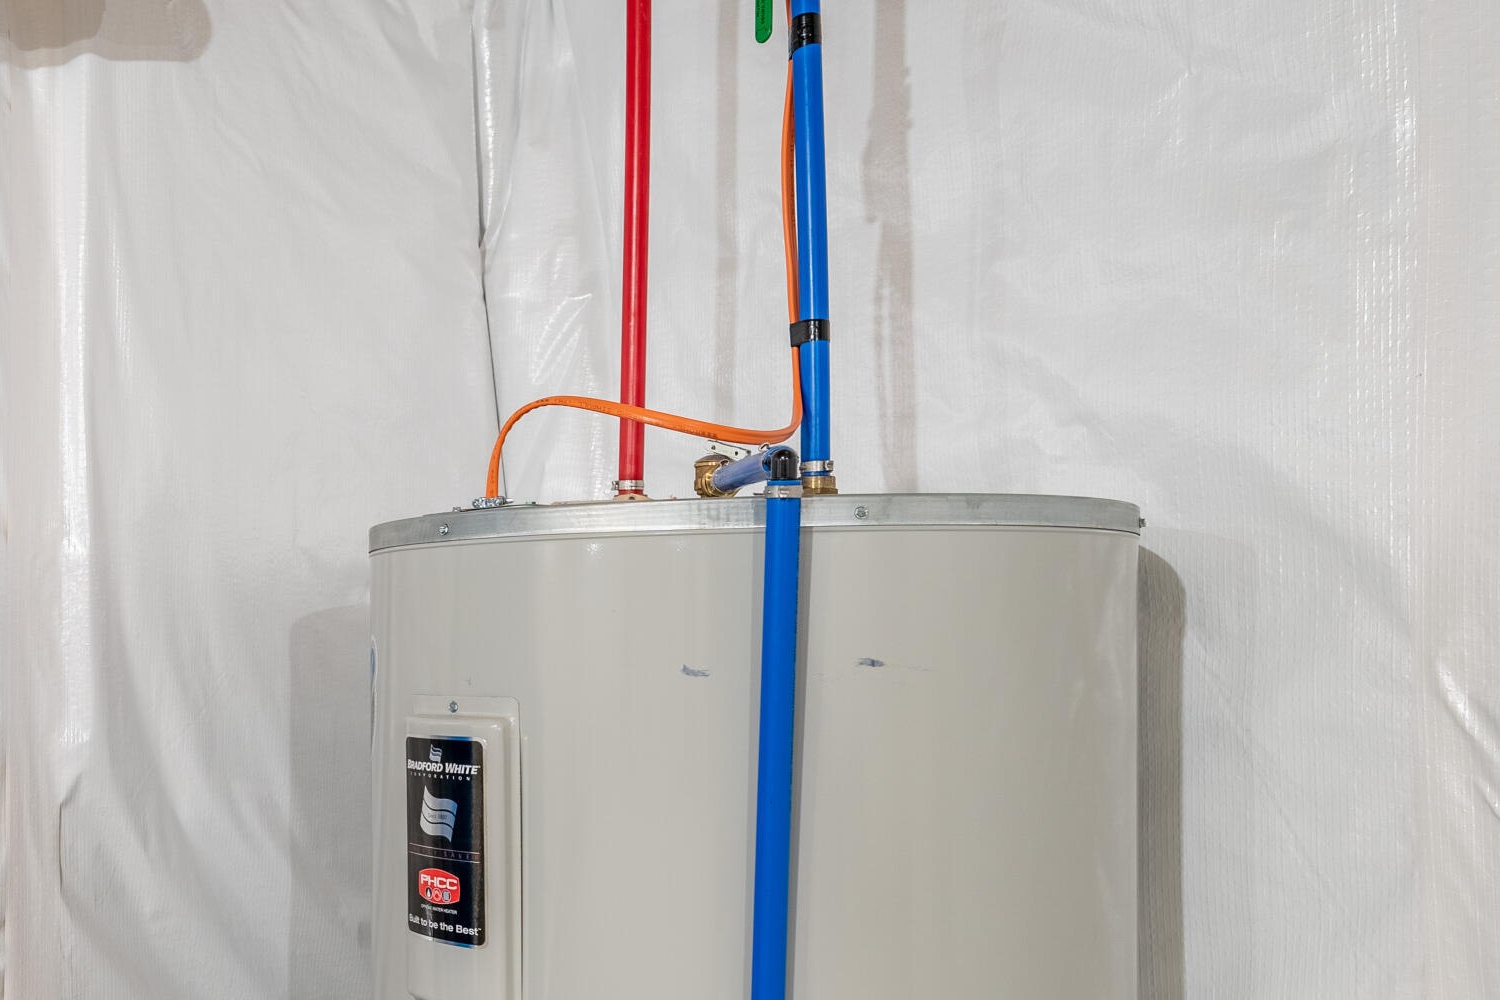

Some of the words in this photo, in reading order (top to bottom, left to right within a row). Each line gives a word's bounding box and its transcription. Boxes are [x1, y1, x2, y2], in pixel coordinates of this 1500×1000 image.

[407, 759, 443, 772] BRADFORD
[445, 762, 478, 775] WHITE
[420, 874, 458, 890] PHCC
[421, 918, 427, 927] to
[429, 919, 438, 929] be
[439, 921, 454, 932] the
[455, 924, 478, 936] Best
